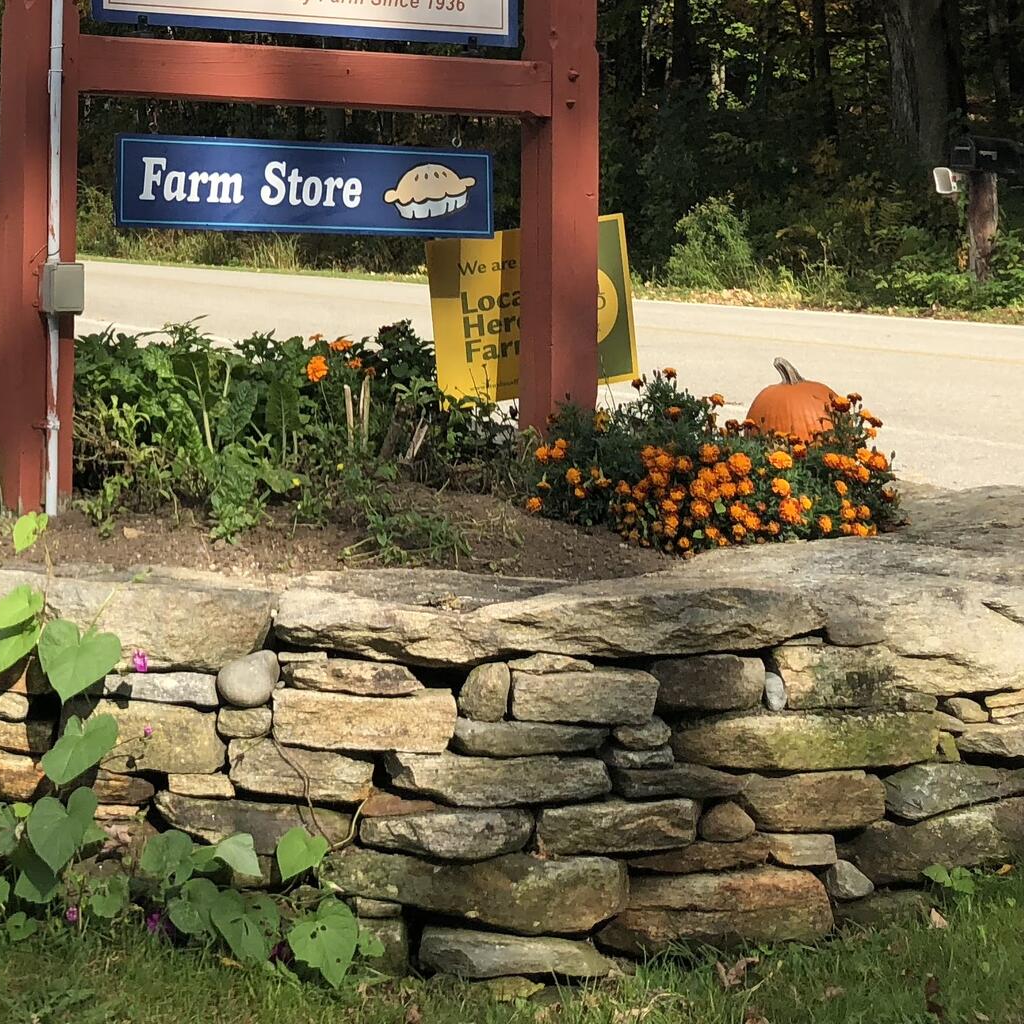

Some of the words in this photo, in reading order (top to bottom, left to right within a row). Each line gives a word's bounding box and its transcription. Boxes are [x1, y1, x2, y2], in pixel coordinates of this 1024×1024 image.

[138, 156, 245, 205] Farm
[260, 160, 363, 209] Store
[458, 260, 487, 275] We
[492, 257, 517, 270] are
[463, 314, 521, 338] Her
